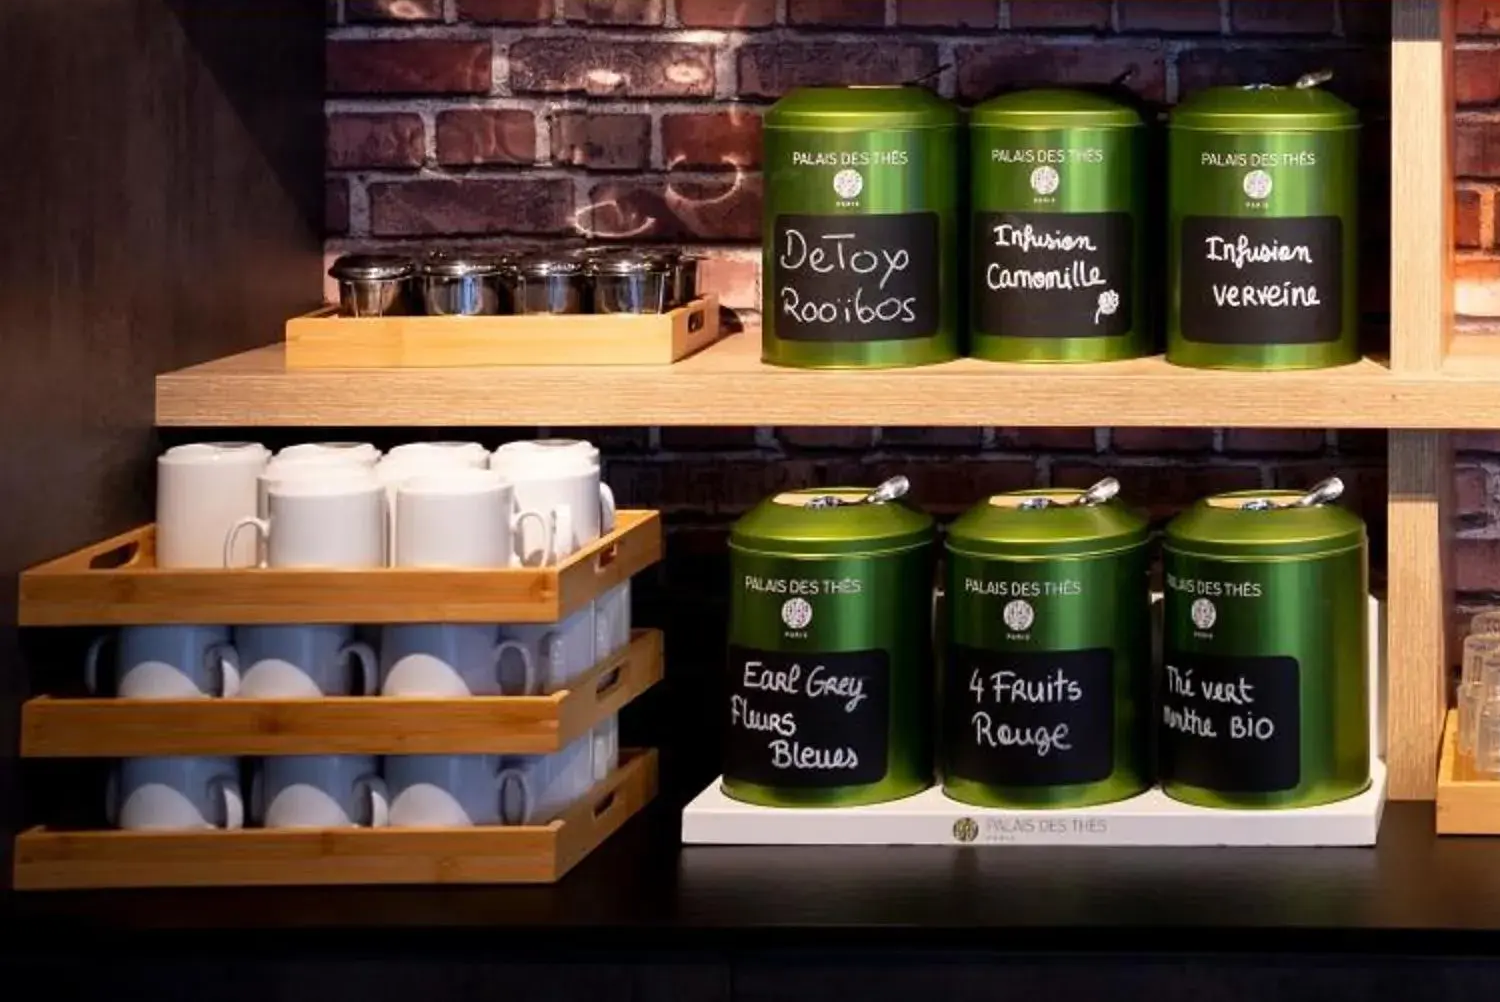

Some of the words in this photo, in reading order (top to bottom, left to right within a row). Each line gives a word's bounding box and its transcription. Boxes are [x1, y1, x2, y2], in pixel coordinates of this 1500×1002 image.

[793, 151, 837, 165] PALAIS
[841, 151, 870, 165] DES
[991, 149, 1035, 163] PALAIS
[1037, 149, 1065, 163] DES
[1201, 152, 1247, 166] PALAIS
[1251, 153, 1278, 166] DES
[993, 223, 1097, 253] Infusion
[1204, 233, 1313, 269] Infusion
[986, 260, 1107, 290] Camomille
[745, 576, 787, 593] PALAIS
[789, 579, 820, 594] DES
[965, 578, 1008, 595] PALAIS
[1011, 582, 1041, 596] DES
[1197, 581, 1222, 596] DES
[743, 661, 801, 693] Earl
[805, 666, 867, 713] Grey
[969, 668, 985, 703] 4
[990, 668, 1083, 703] Fruits
[1166, 664, 1196, 697] Thé
[971, 711, 1072, 756] Rouge
[768, 739, 859, 769] Bleues
[1039, 818, 1068, 833] DES
